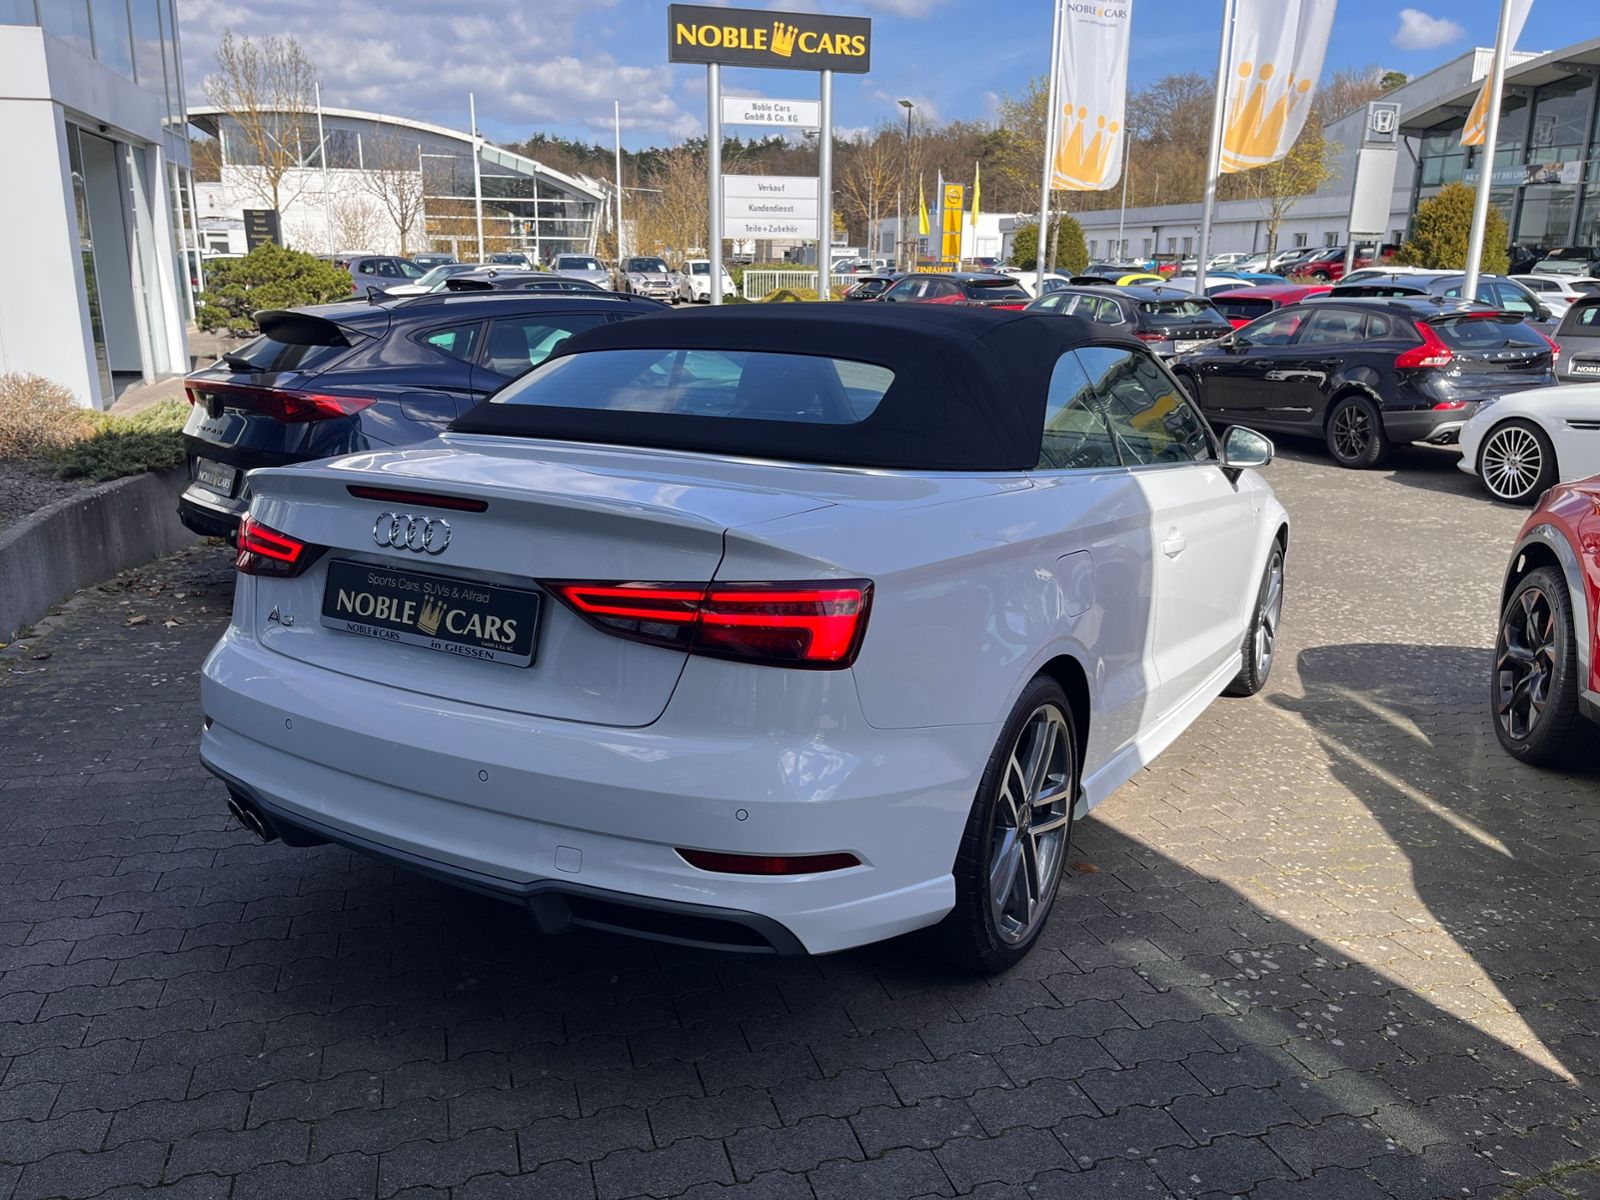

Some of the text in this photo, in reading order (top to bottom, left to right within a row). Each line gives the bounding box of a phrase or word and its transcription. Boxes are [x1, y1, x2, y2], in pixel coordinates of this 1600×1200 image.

[1067, 3, 1127, 19] NOBLE CARS
[676, 23, 866, 56] NOBLE CARS
[752, 103, 791, 112] Noble Cars
[744, 112, 799, 123] GmbH & Co. KG
[758, 183, 785, 192] Verkauf
[748, 204, 795, 213] Kundendienst
[367, 572, 397, 588] Sports
[422, 582, 450, 597] SUVs
[451, 587, 460, 599] &
[461, 589, 491, 604] Allrad
[336, 588, 518, 644] NOBLE CARS
[346, 623, 400, 641] NOBLE CARS
[431, 640, 496, 660] in GIESSEN
